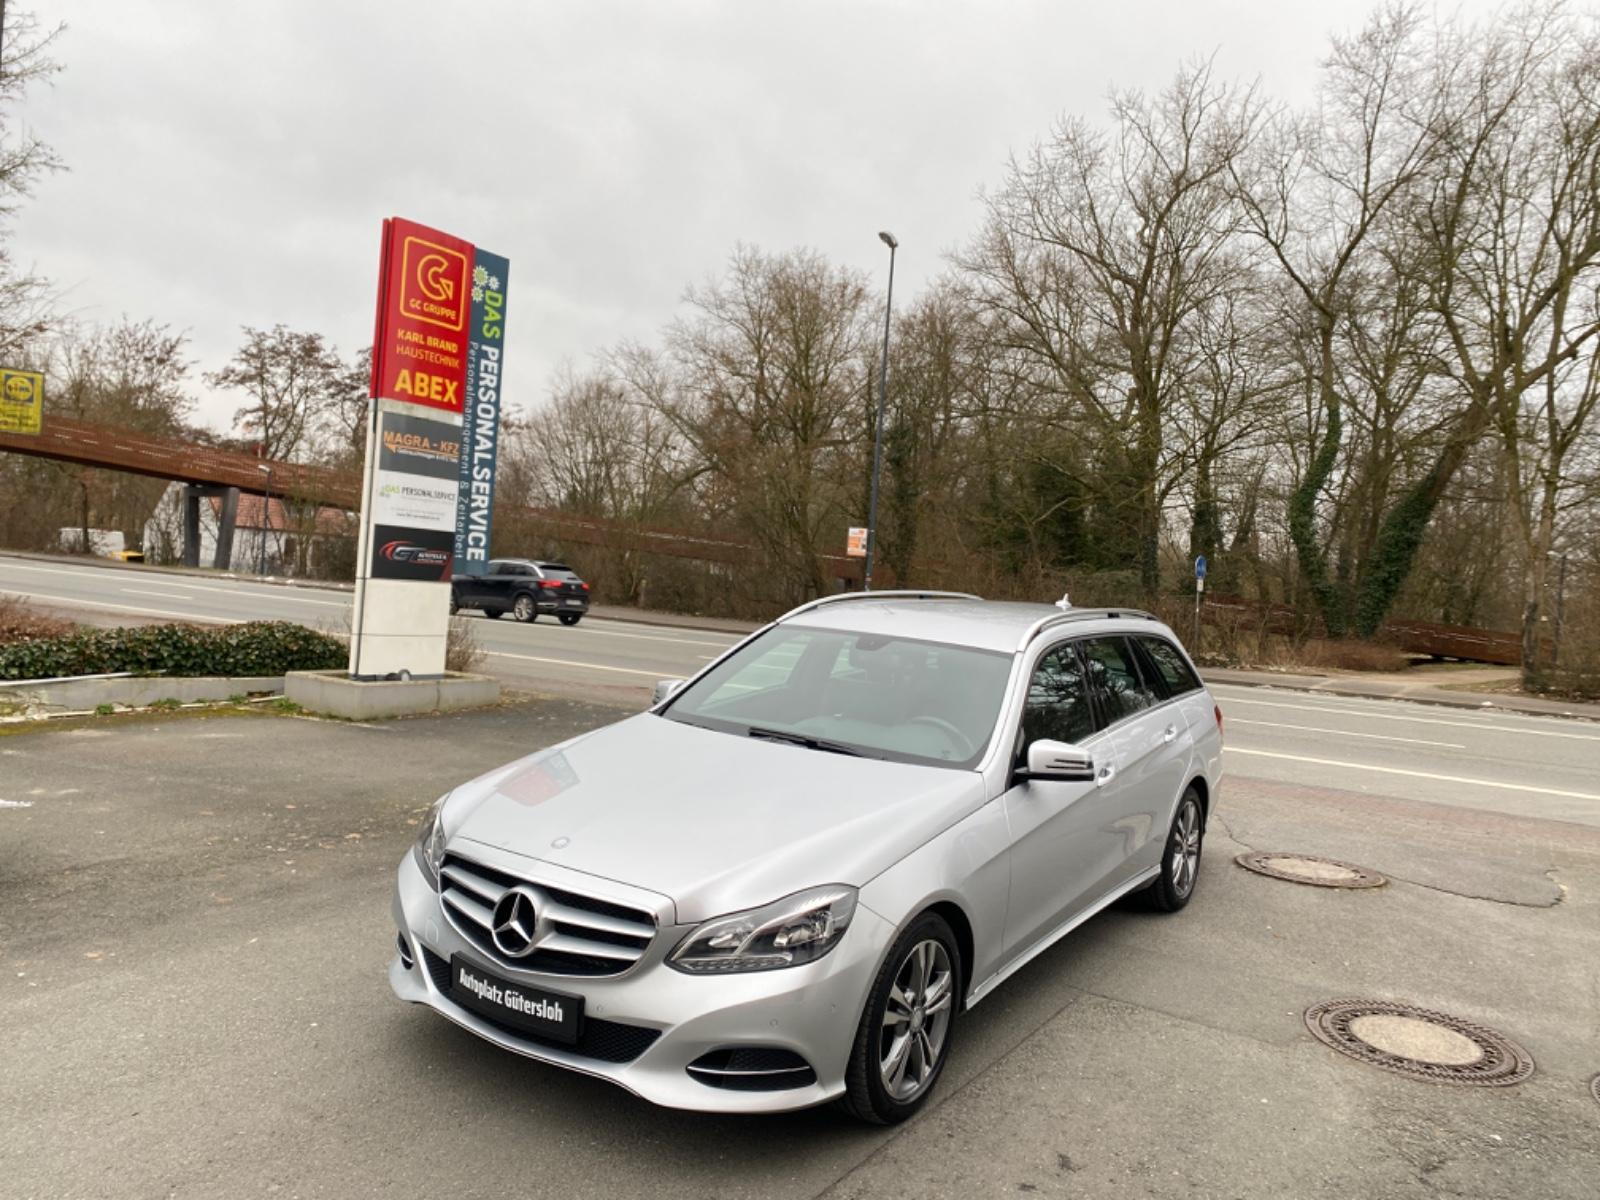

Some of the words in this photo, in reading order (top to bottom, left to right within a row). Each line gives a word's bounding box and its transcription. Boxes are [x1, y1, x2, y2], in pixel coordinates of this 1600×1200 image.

[409, 298, 421, 310] GC
[423, 301, 456, 320] GRUPPE
[482, 289, 503, 339] DAS
[396, 345, 459, 368] HAUSTECHNIK
[397, 328, 425, 344] KARL
[426, 337, 458, 353] BRAND
[394, 369, 459, 405] ABEX
[383, 430, 431, 449] MAGRA
[440, 440, 459, 454] KFZ
[466, 344, 500, 561] PERSONALSERVICE
[454, 497, 470, 558] Zeitarbeit
[459, 967, 503, 1004] Autoplatz
[504, 990, 563, 1023] Gütersloh
